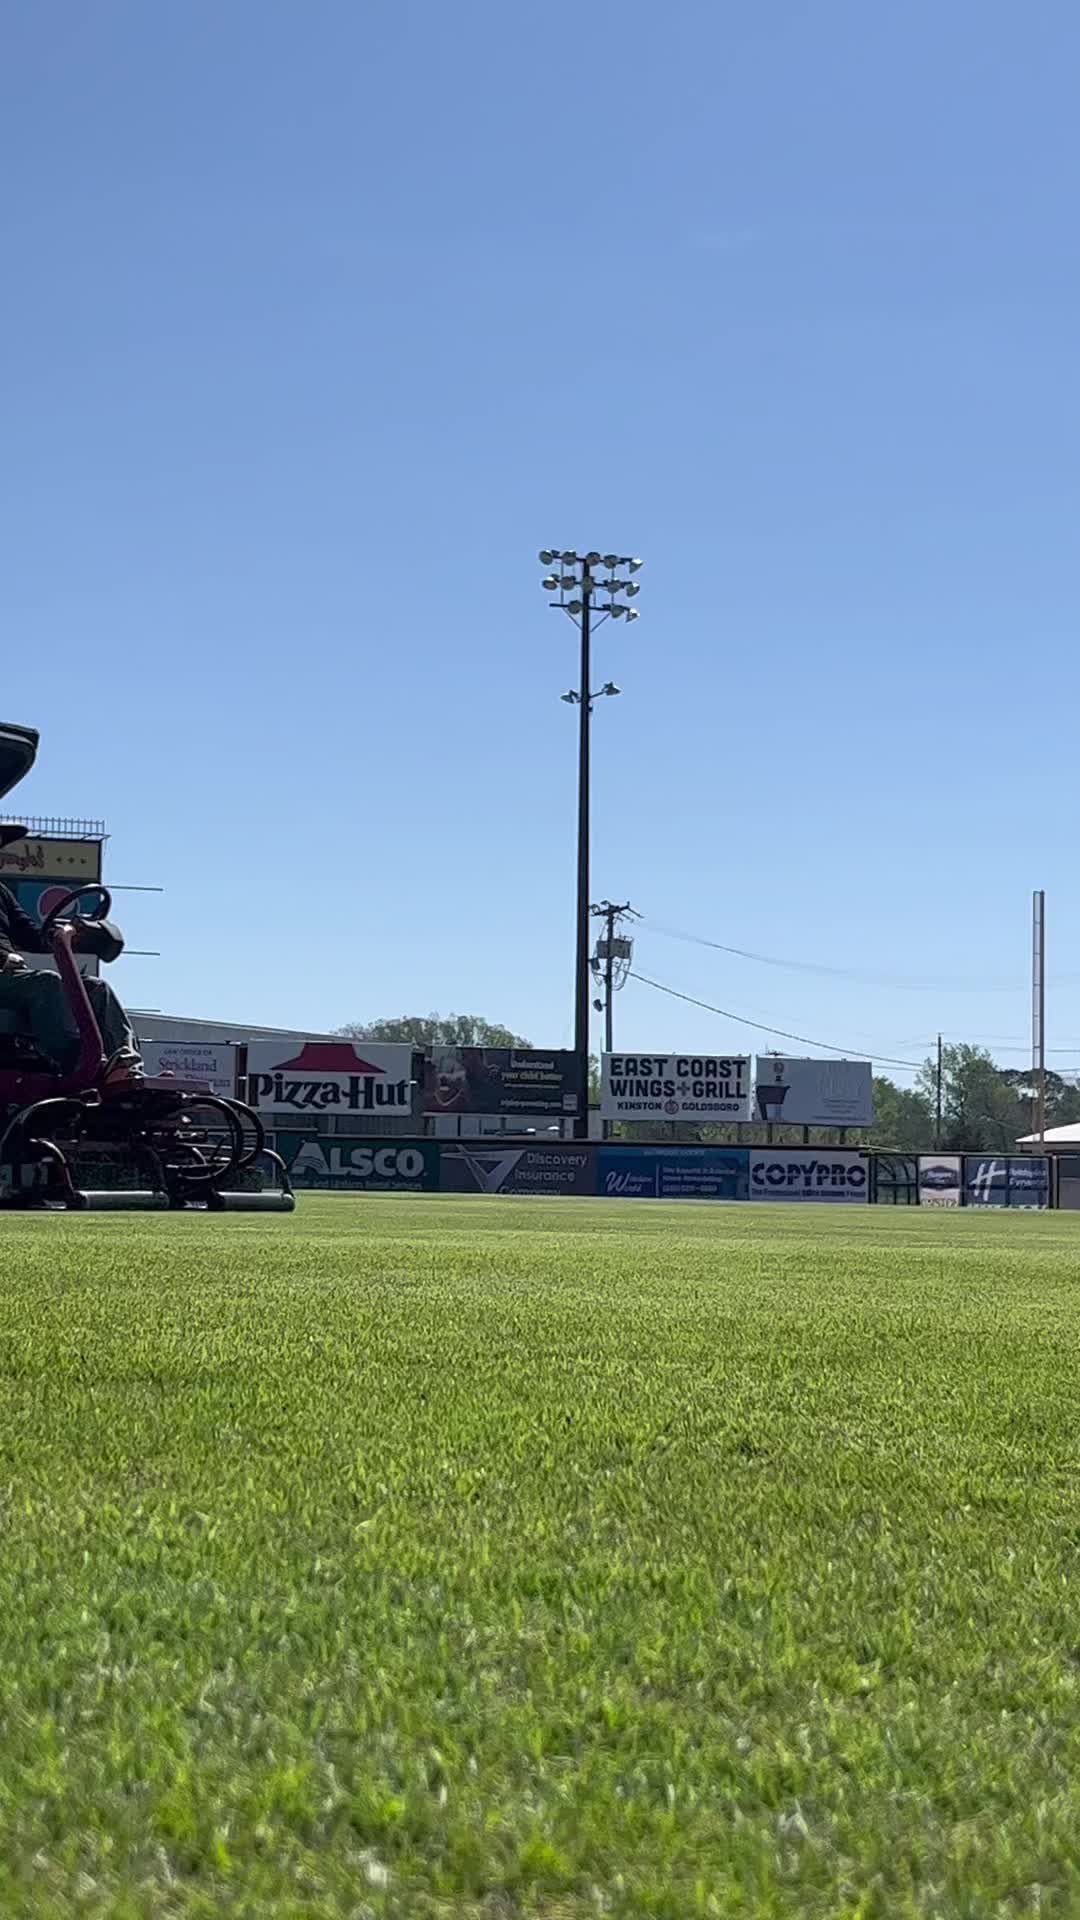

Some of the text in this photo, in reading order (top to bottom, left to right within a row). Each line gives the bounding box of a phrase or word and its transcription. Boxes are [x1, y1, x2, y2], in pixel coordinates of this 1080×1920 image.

[610, 1057, 747, 1079] EAST COAST
[247, 1073, 408, 1110] Pizza Hut
[617, 1101, 740, 1112] KINSTON GOLDSBORO
[290, 1140, 425, 1178] ALSCO
[526, 1153, 588, 1169] Discovery
[513, 1169, 576, 1182] Insurance
[751, 1160, 866, 1187] COPYPRO
